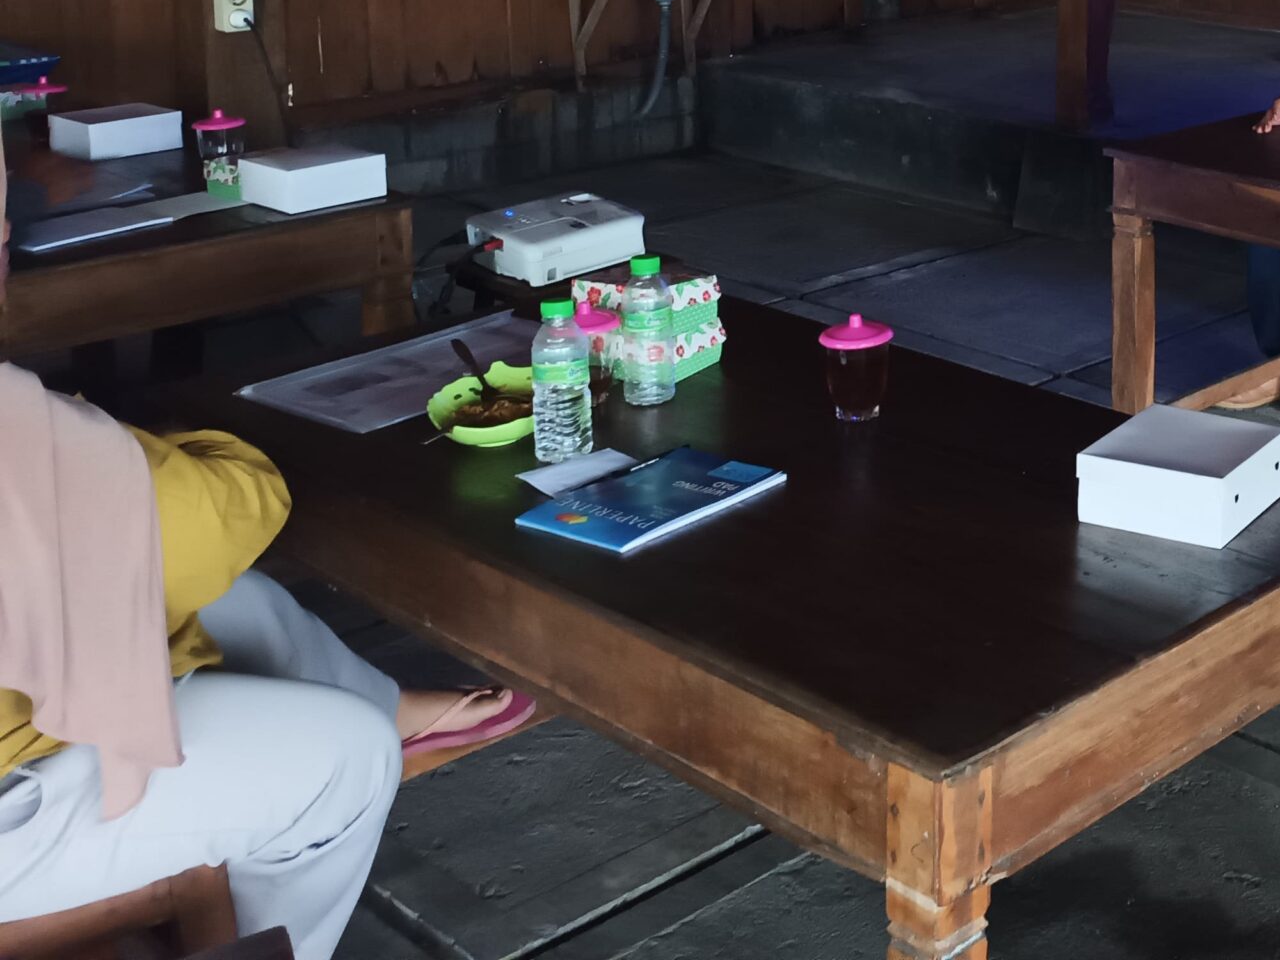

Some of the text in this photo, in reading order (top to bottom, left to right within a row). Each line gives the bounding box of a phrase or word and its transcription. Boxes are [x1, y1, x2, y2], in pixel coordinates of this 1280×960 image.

[672, 480, 727, 497] WRITING
[712, 481, 741, 491] PAD
[555, 497, 656, 529] PAPERLINE
